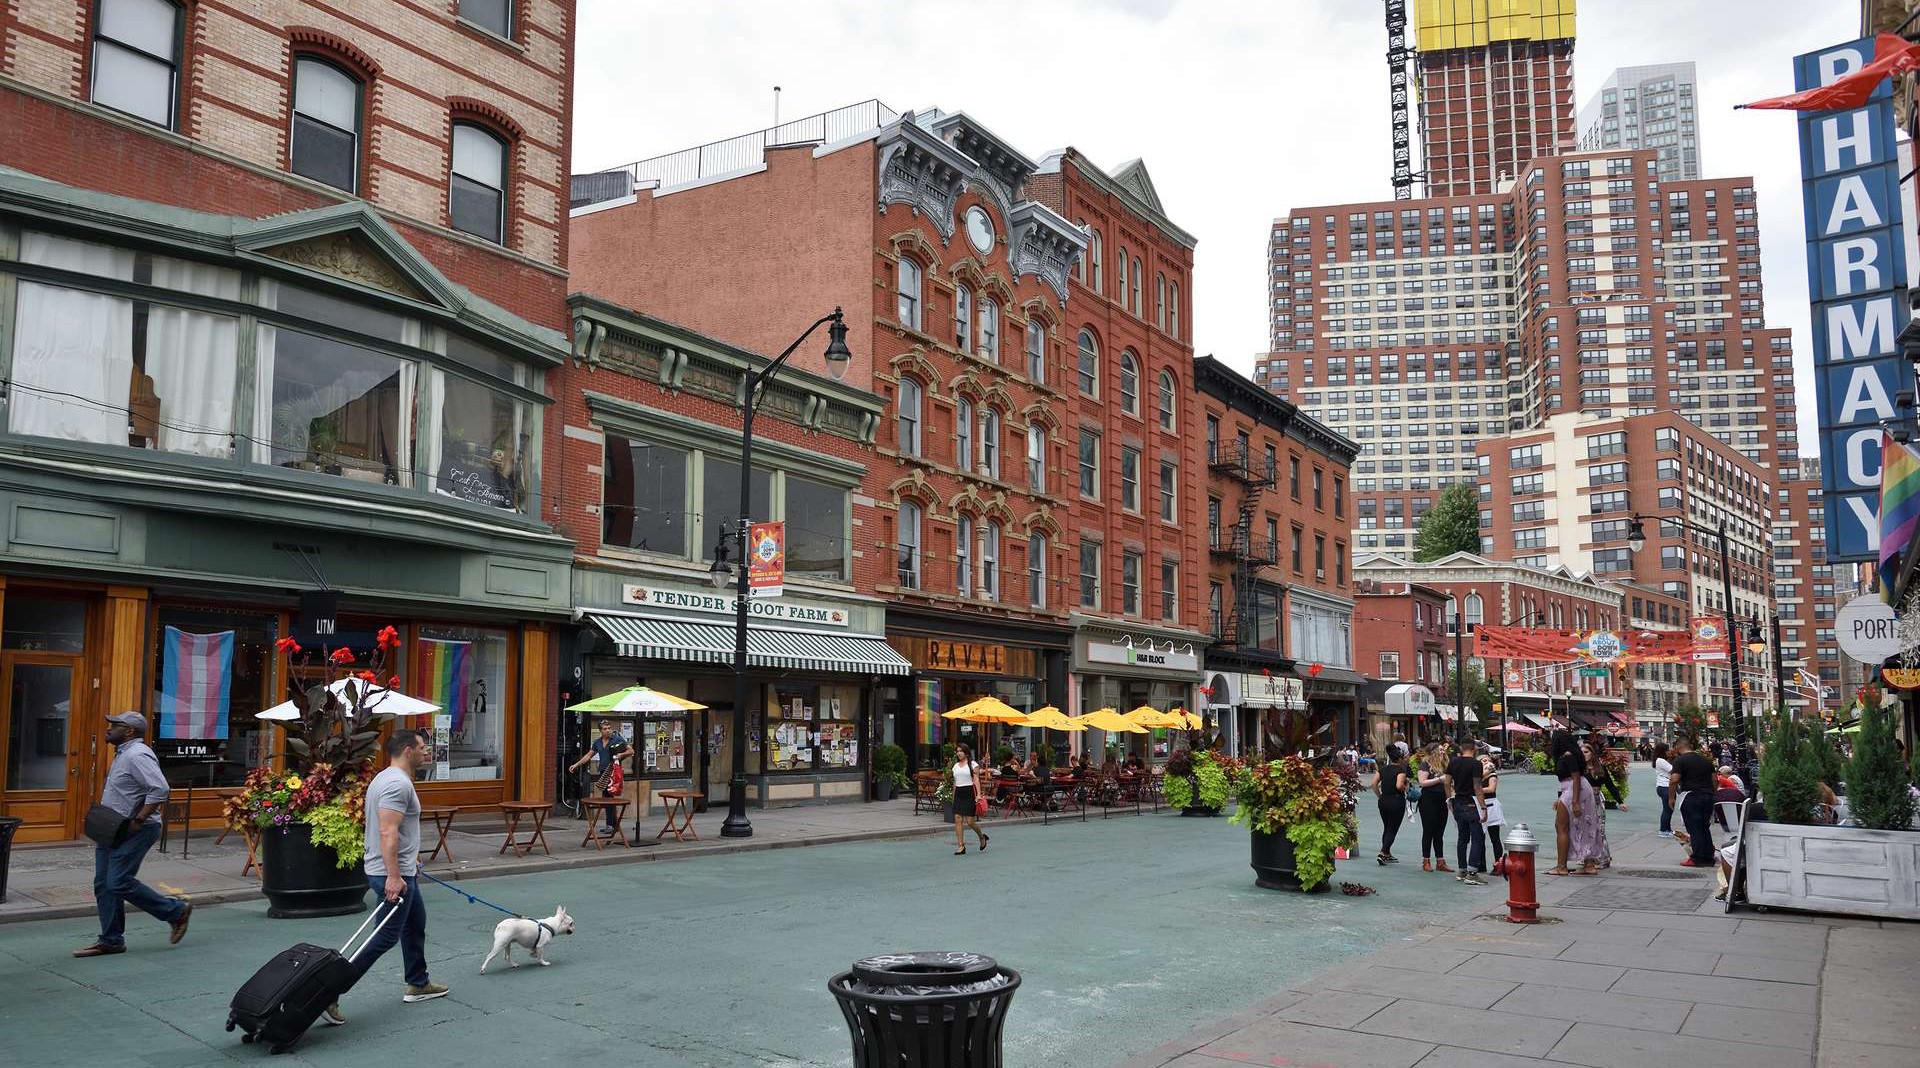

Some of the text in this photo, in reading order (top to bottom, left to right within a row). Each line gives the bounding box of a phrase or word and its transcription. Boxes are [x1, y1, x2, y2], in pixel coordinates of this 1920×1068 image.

[653, 590, 726, 611] TENDER
[789, 607, 828, 622] FARM
[316, 619, 335, 635] LITM
[930, 641, 1002, 671] RAVAL
[1136, 653, 1166, 665] H&R BLOCK
[177, 746, 207, 755] LITM
